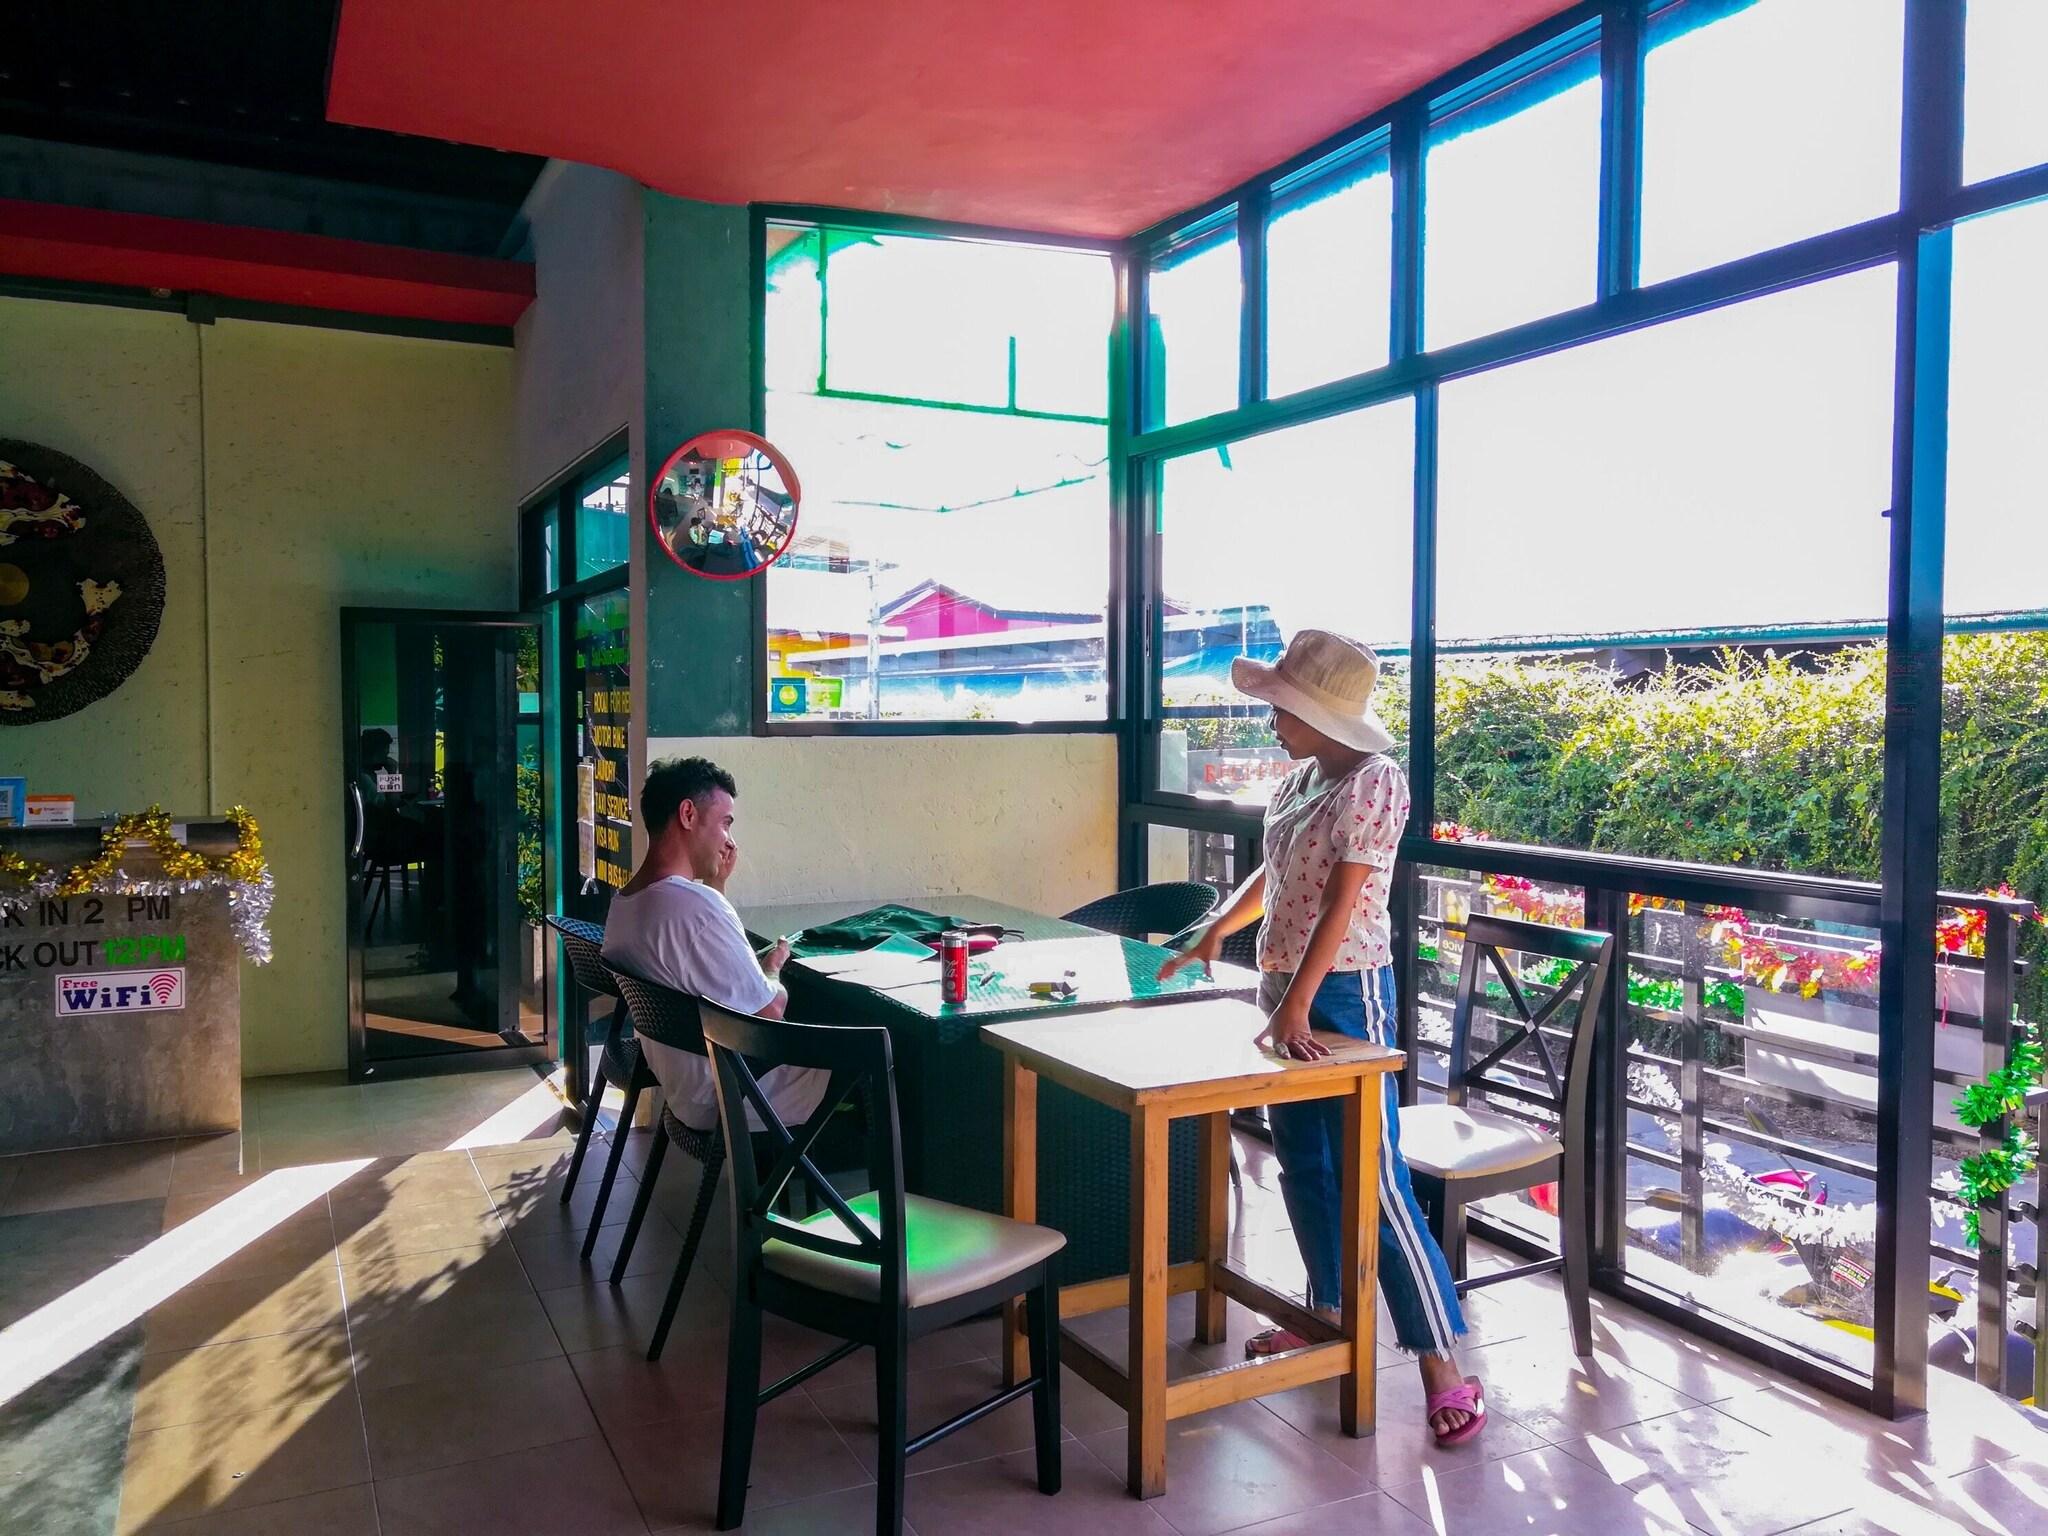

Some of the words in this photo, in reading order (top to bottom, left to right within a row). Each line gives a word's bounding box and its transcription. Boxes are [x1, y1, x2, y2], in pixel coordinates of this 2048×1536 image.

[593, 691, 608, 713] ROOM
[610, 690, 620, 713] FOR
[621, 690, 631, 713] RE
[593, 726, 612, 747] MOTOR
[612, 726, 625, 748] BIKE
[595, 791, 606, 815] TAXI
[607, 794, 629, 820] SERVICE
[595, 825, 607, 849] VISA
[608, 827, 620, 853] RUN
[40, 900, 68, 927] IN
[83, 898, 105, 925] 2
[127, 896, 170, 922] PM
[33, 940, 98, 967] OUT
[103, 934, 186, 966] 12PM
[62, 979, 98, 989] Free
[62, 984, 151, 1010] WiFi
